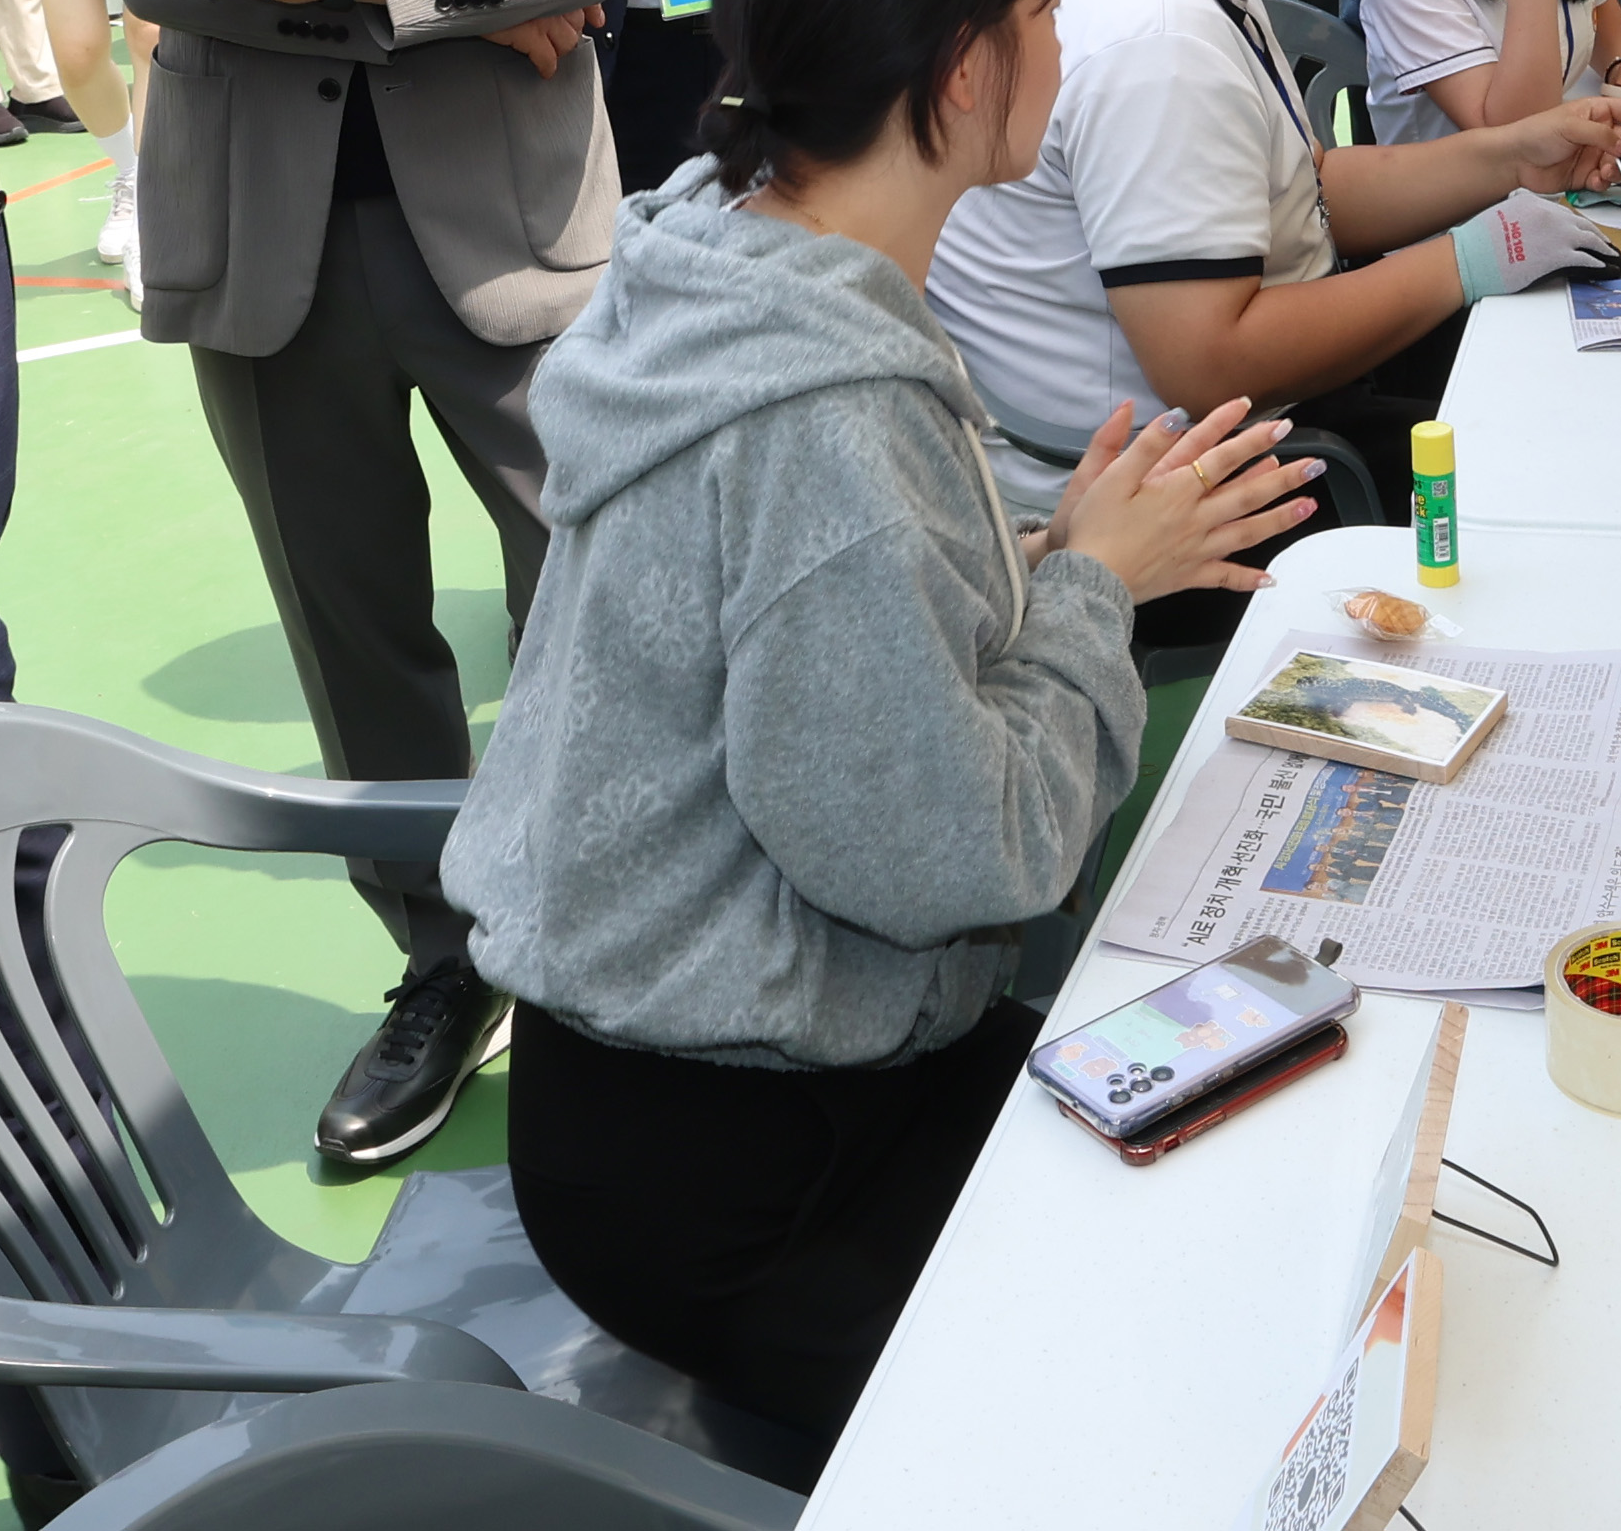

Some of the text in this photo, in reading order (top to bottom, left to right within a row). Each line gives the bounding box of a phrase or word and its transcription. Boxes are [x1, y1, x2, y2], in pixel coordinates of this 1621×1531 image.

[1199, 893, 1233, 920] 정치
[1269, 769, 1298, 791] 불신
[1595, 941, 1608, 950] 3M
[1593, 954, 1619, 966] Scotch
[1605, 968, 1620, 977] 3M
